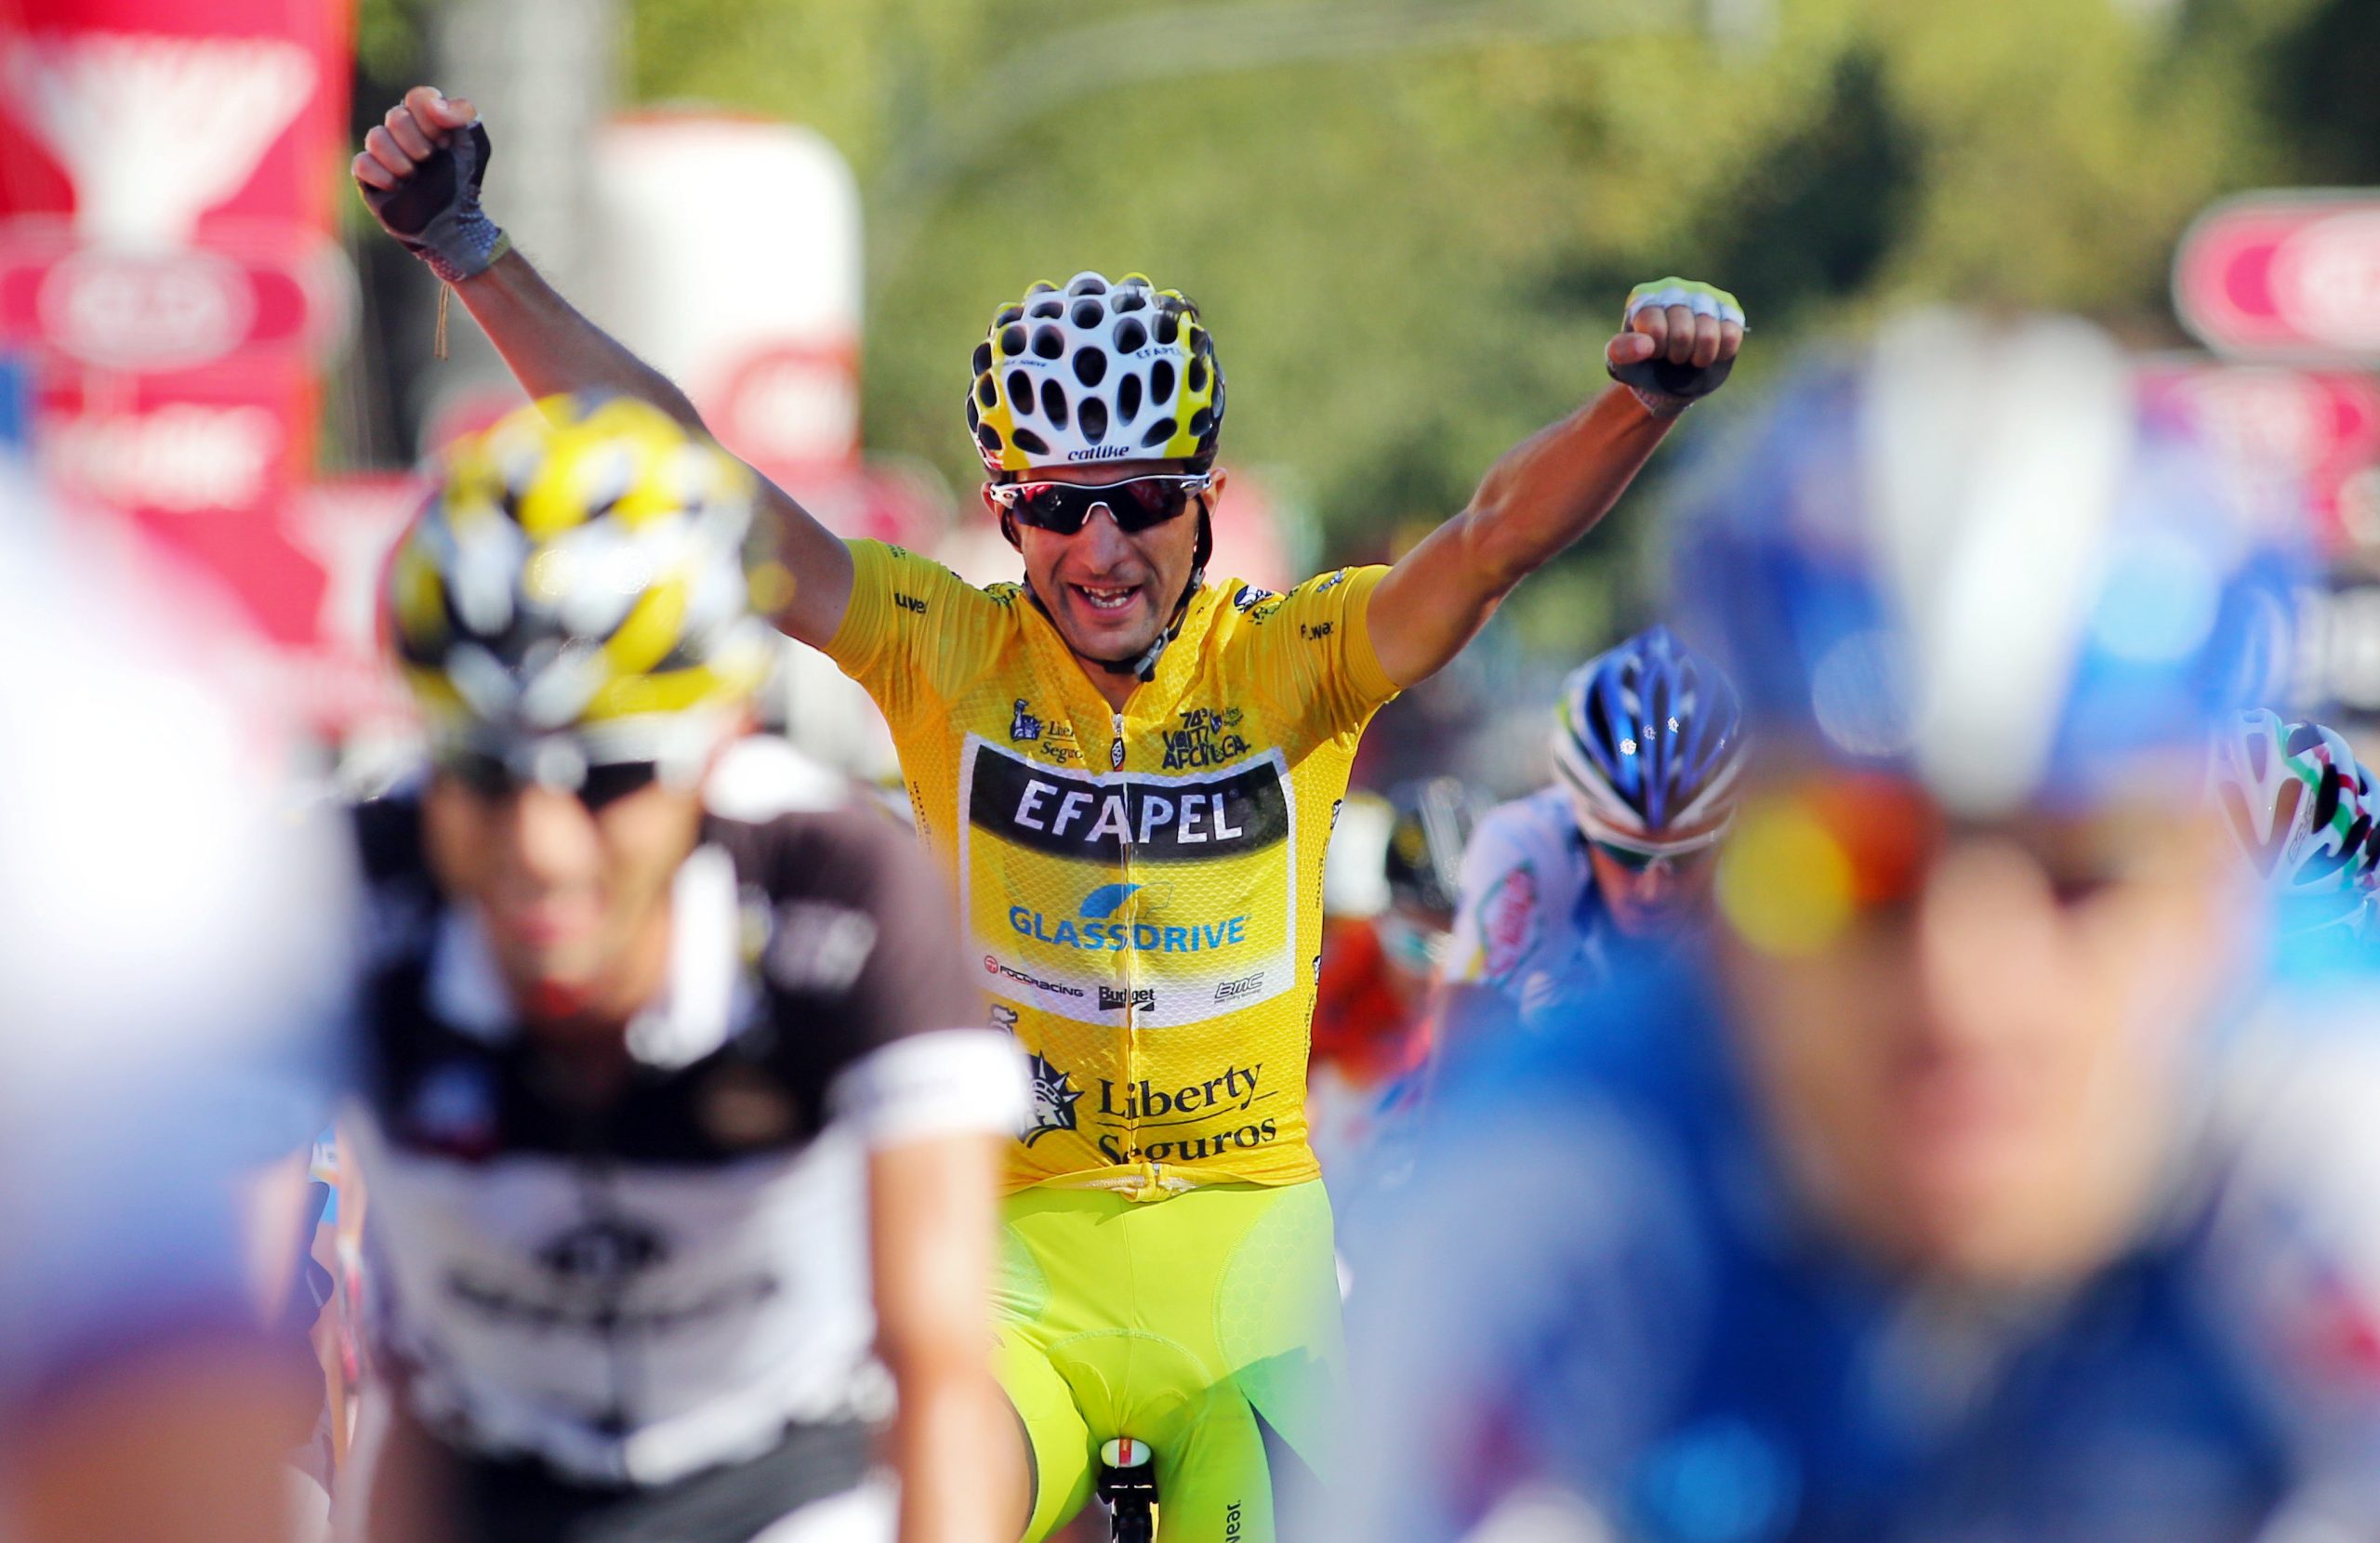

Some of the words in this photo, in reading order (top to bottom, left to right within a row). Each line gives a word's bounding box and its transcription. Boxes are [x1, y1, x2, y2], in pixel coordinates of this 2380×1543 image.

[1014, 779, 1243, 845] EFAPEL
[1009, 905, 1248, 953] GLASSDRIVE
[1099, 986, 1156, 1005] Budget
[1097, 1063, 1263, 1120] Liberty
